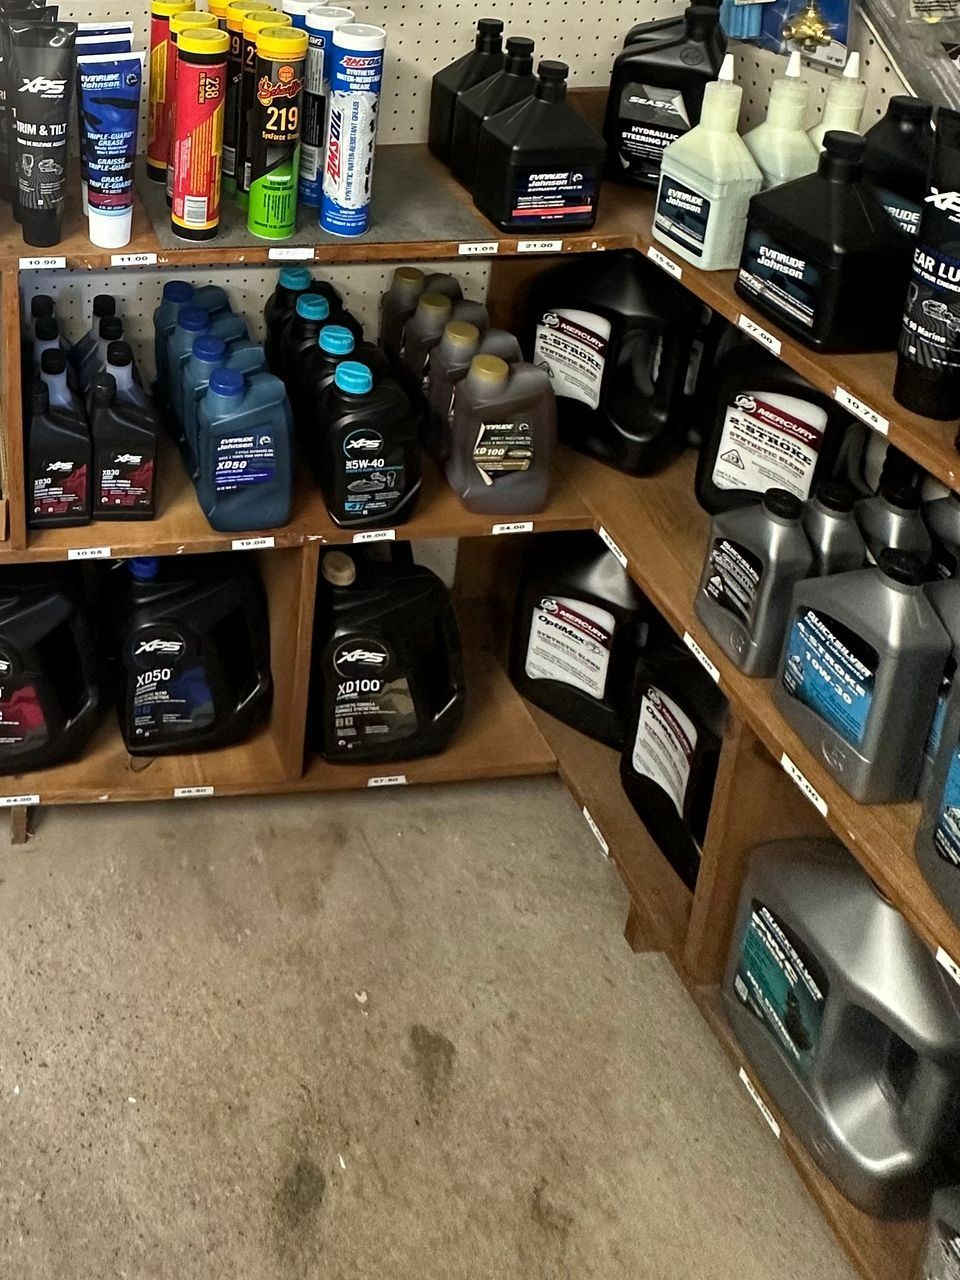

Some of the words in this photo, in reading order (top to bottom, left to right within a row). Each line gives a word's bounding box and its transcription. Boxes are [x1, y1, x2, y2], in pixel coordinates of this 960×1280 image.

[341, 55, 382, 68] AMSOIL
[17, 76, 68, 93] XPS
[80, 80, 120, 89] Johnson
[205, 76, 221, 100] 238
[266, 106, 299, 131] 219
[16, 120, 39, 134] TRIM
[39, 123, 48, 136] &
[49, 122, 67, 136] TILT
[631, 124, 678, 141] HYDRAULIC
[622, 131, 661, 147] STEERING
[101, 175, 124, 183] GRASA
[528, 172, 568, 182] EVINRUDE
[528, 179, 568, 188] Johnson
[665, 196, 703, 215] Johnson
[667, 188, 704, 207] EVINRUDE
[525, 241, 554, 250] 21.00
[27, 258, 58, 266] 10.90
[119, 255, 149, 263] 11.00
[759, 244, 806, 271] EVINRUDE
[757, 255, 804, 280] Johnson
[560, 323, 605, 349] MERCURY
[917, 326, 947, 344] Marine
[539, 332, 602, 371] 2-STROKE
[844, 395, 880, 424] 10.75
[757, 407, 817, 440] MERCURY
[217, 442, 254, 451] Johnson
[345, 438, 382, 451] XPS
[729, 415, 813, 466] 2-STROKE
[729, 431, 778, 459] SYNTHETIC
[779, 455, 805, 476] BLEND
[215, 460, 248, 470] XD50
[352, 458, 385, 469] 5W-40
[239, 539, 267, 547] 19.00
[361, 532, 387, 540] 18.00
[538, 615, 585, 644] OptiMax
[559, 609, 609, 641] MERCURY
[133, 638, 185, 655] XPS
[806, 610, 874, 678] QUICKSILVER
[336, 648, 387, 666] XPS
[797, 621, 866, 698] 4-STROKE
[136, 668, 172, 688] XD50
[337, 678, 381, 695] XD100
[805, 650, 853, 705] 10W-30
[790, 771, 820, 803] 14.00
